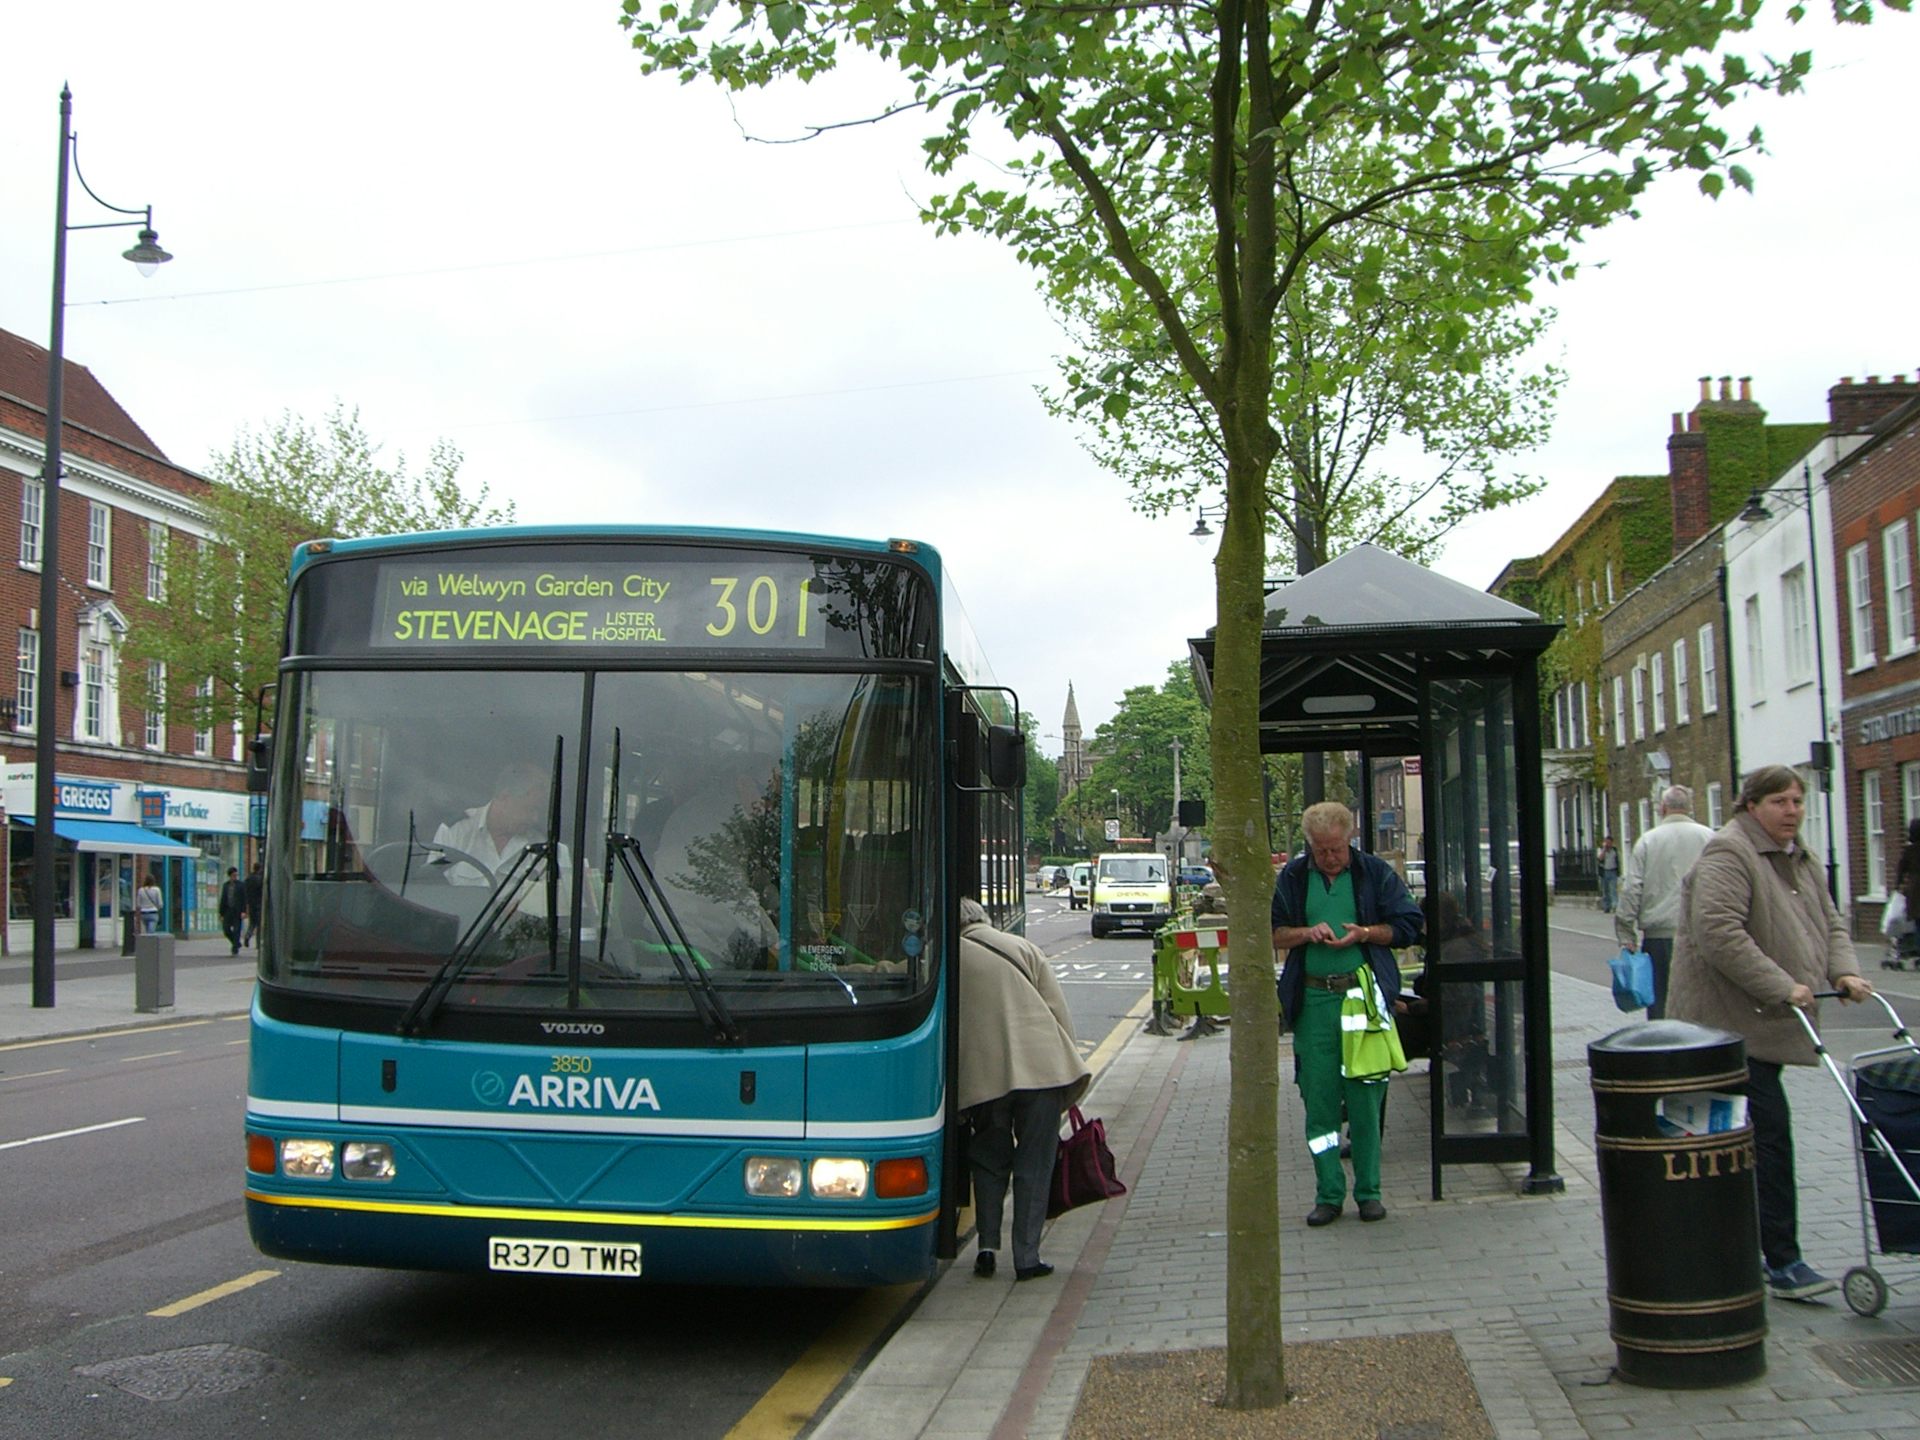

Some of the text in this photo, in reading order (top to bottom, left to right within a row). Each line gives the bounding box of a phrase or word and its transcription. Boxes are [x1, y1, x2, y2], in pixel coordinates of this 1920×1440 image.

[401, 574, 670, 603] via Welwyn Garden City
[706, 577, 810, 637] 301
[394, 610, 588, 641] STEVENAGE
[606, 612, 655, 627] LISTER
[592, 626, 667, 642] HOSPITAL
[61, 785, 111, 810] GREGGS
[182, 801, 209, 819] Choice
[808, 945, 846, 954] EMERGENCY
[541, 1022, 605, 1034] VOLVO
[550, 1055, 591, 1073] 3850
[508, 1074, 661, 1111] ARRIVA
[493, 1243, 639, 1272] R370 TWR
